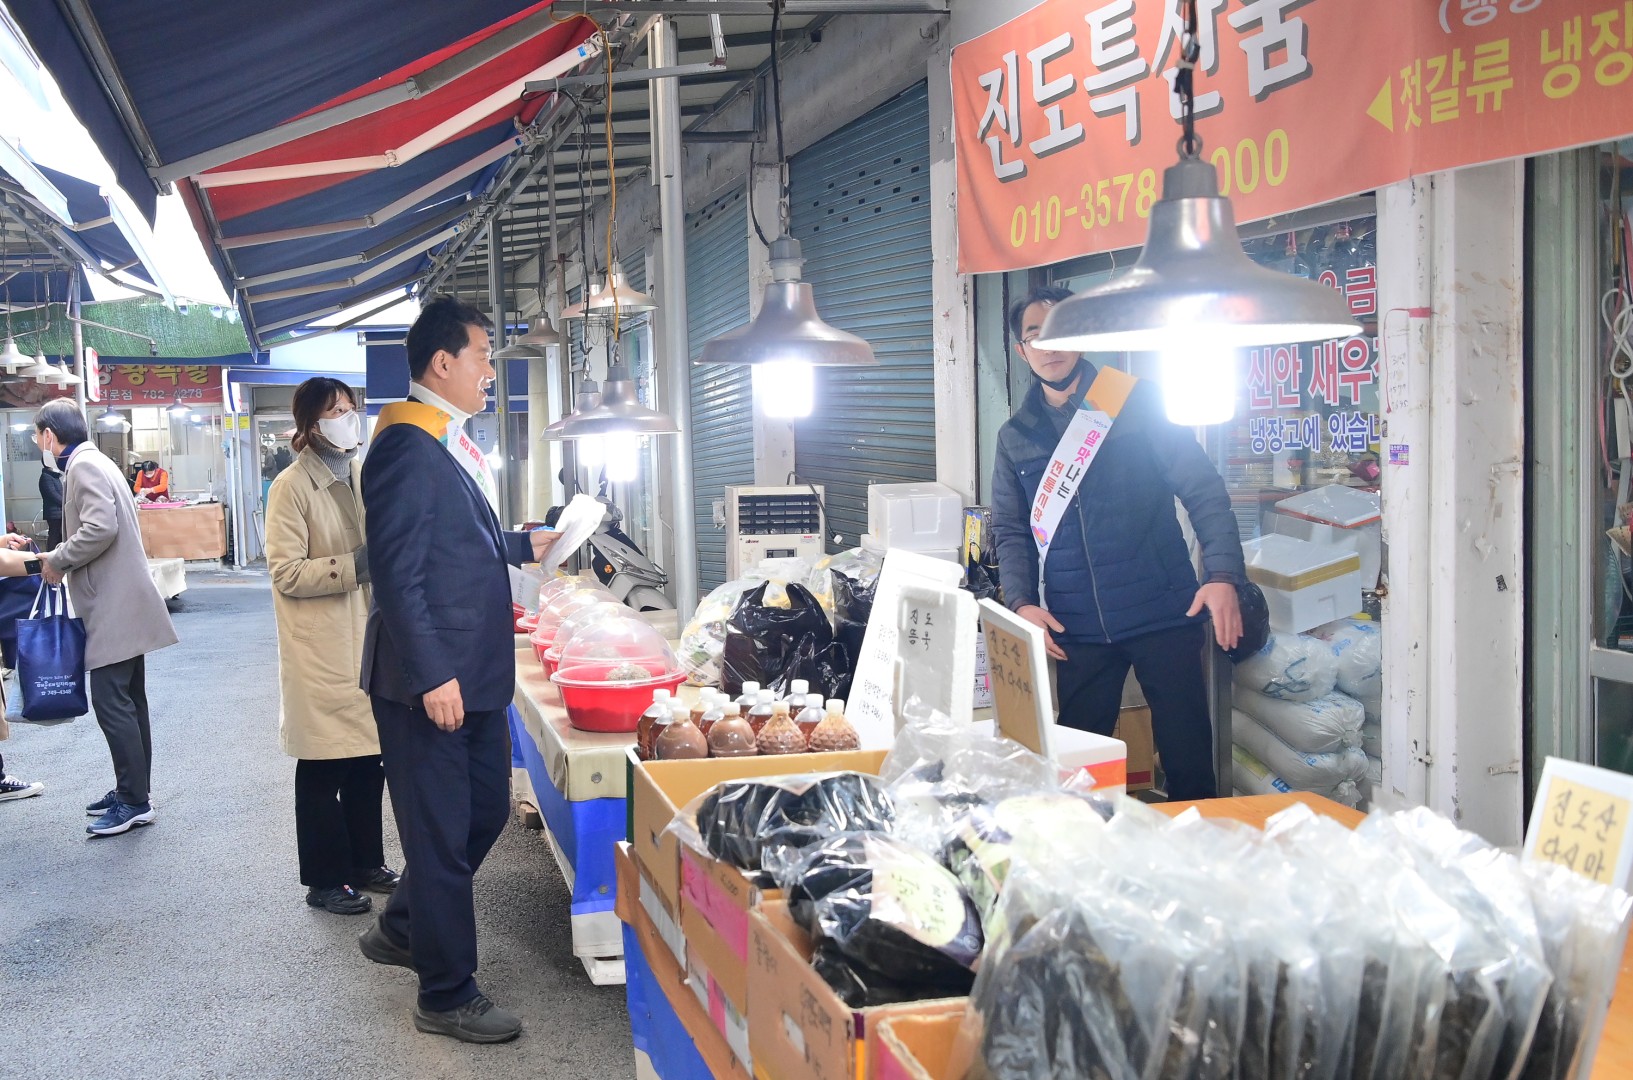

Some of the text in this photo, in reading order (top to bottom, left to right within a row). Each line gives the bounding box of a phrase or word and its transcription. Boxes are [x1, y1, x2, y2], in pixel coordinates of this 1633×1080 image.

[1399, 38, 1514, 133] 젓갈류
[1247, 344, 1303, 410] 신안
[1250, 413, 1321, 454] 냉장고에
[1033, 460, 1065, 523] 전통시장
